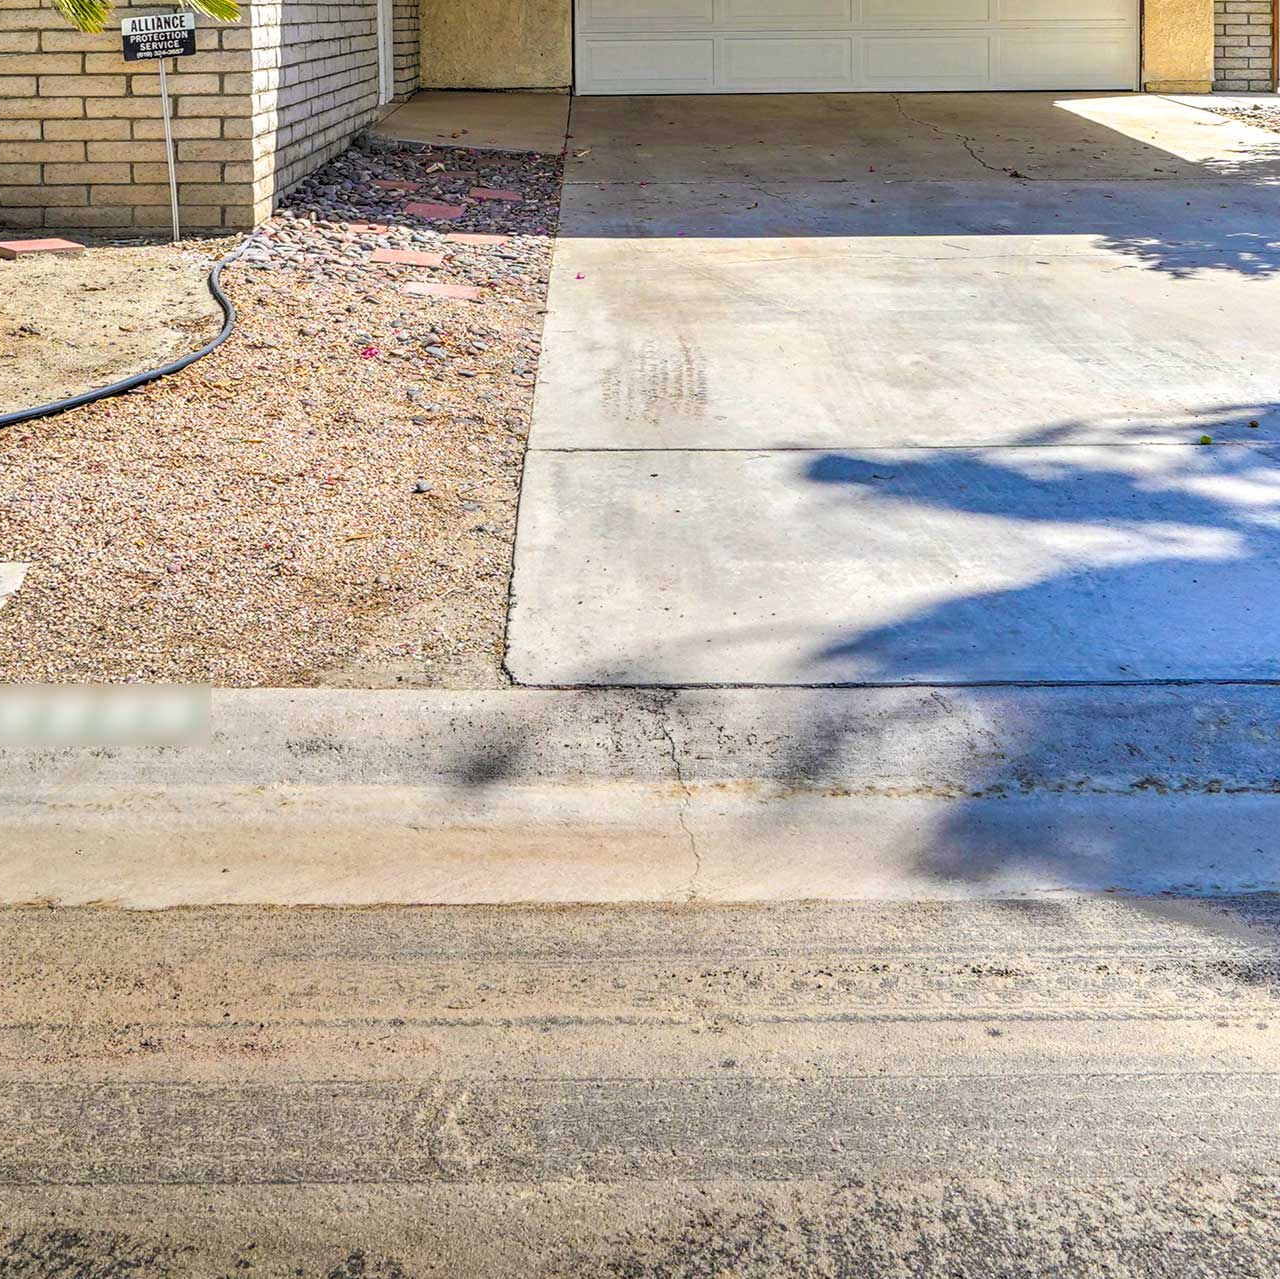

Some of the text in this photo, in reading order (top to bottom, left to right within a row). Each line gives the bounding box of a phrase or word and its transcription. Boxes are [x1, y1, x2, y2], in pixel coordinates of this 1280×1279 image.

[131, 15, 186, 33] ALLIANCE
[130, 30, 188, 44] PROTECTION
[140, 40, 180, 51] SERVICE
